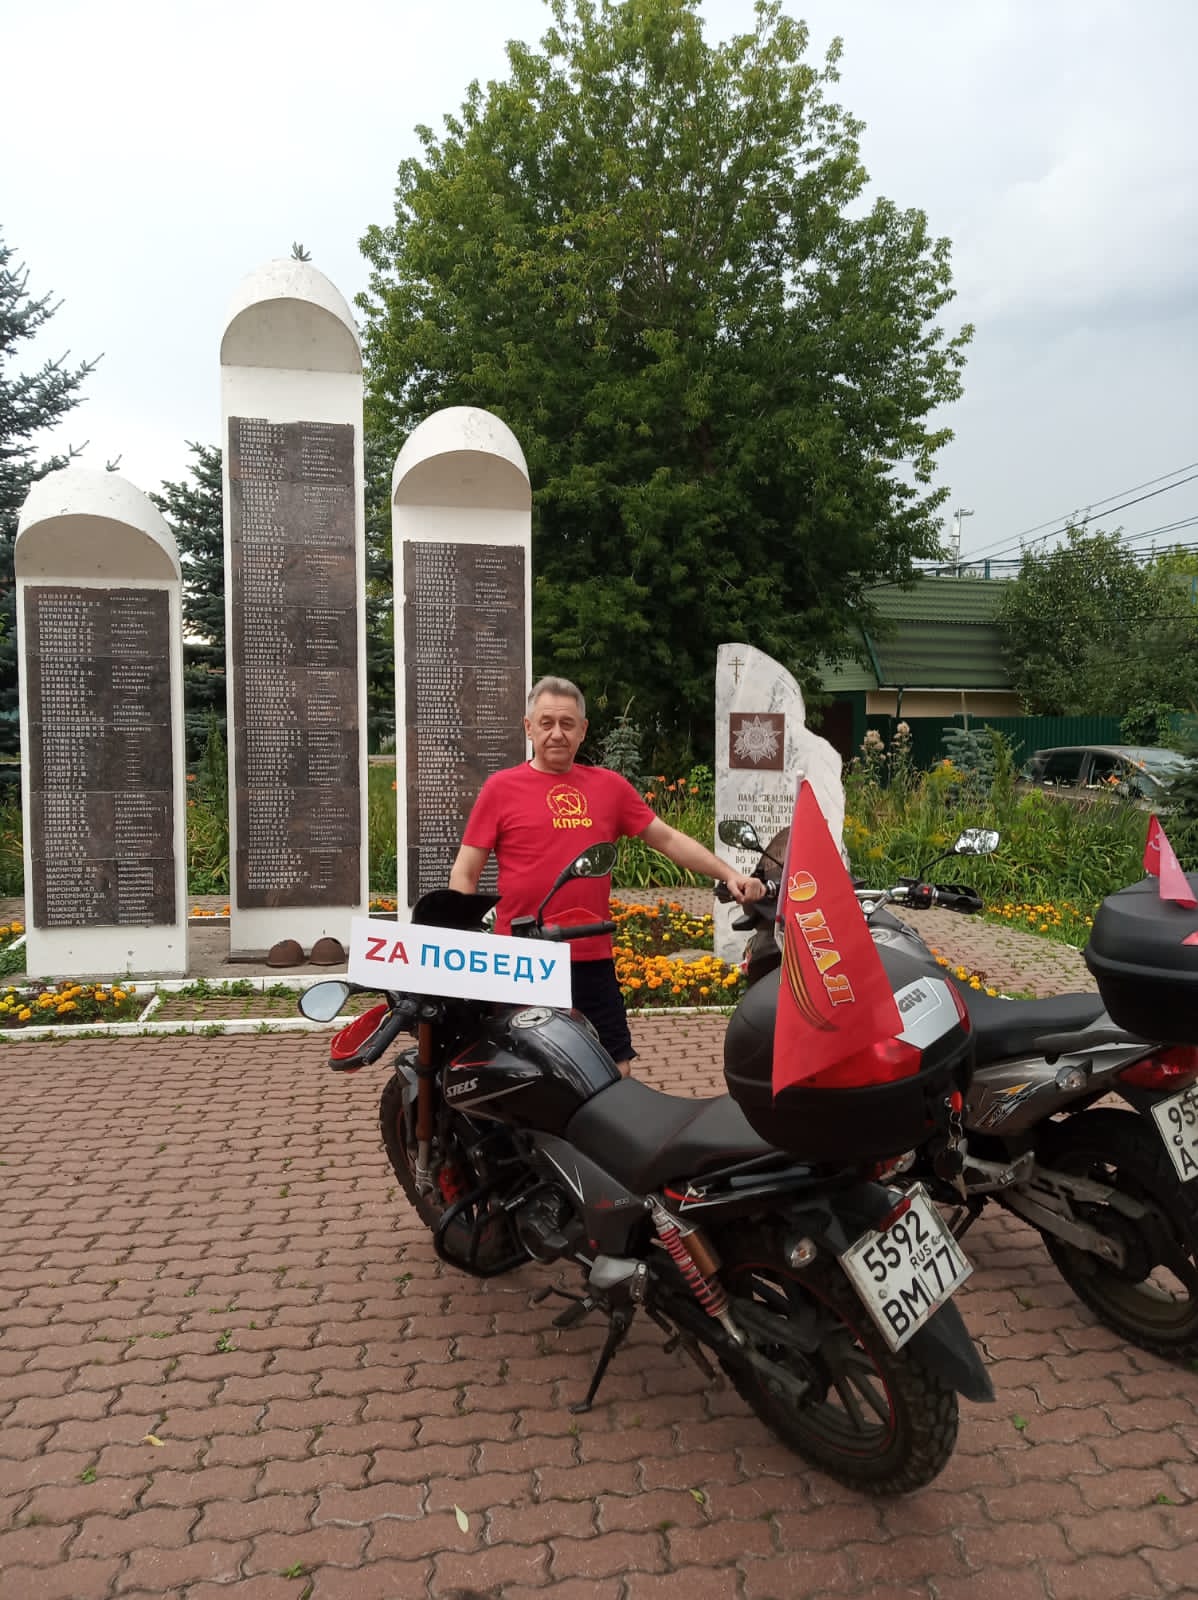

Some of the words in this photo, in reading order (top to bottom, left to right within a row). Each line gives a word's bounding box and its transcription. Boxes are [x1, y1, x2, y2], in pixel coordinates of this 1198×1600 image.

[738, 804, 748, 812] ОТ
[552, 818, 592, 829] КПРФ
[788, 870, 818, 902] 9
[420, 944, 556, 984] ПОБЕДУ
[795, 908, 855, 1007] МАЯ
[446, 1078, 479, 1098] STELS
[862, 1210, 930, 1282] 5592
[910, 1244, 932, 1270] RUS
